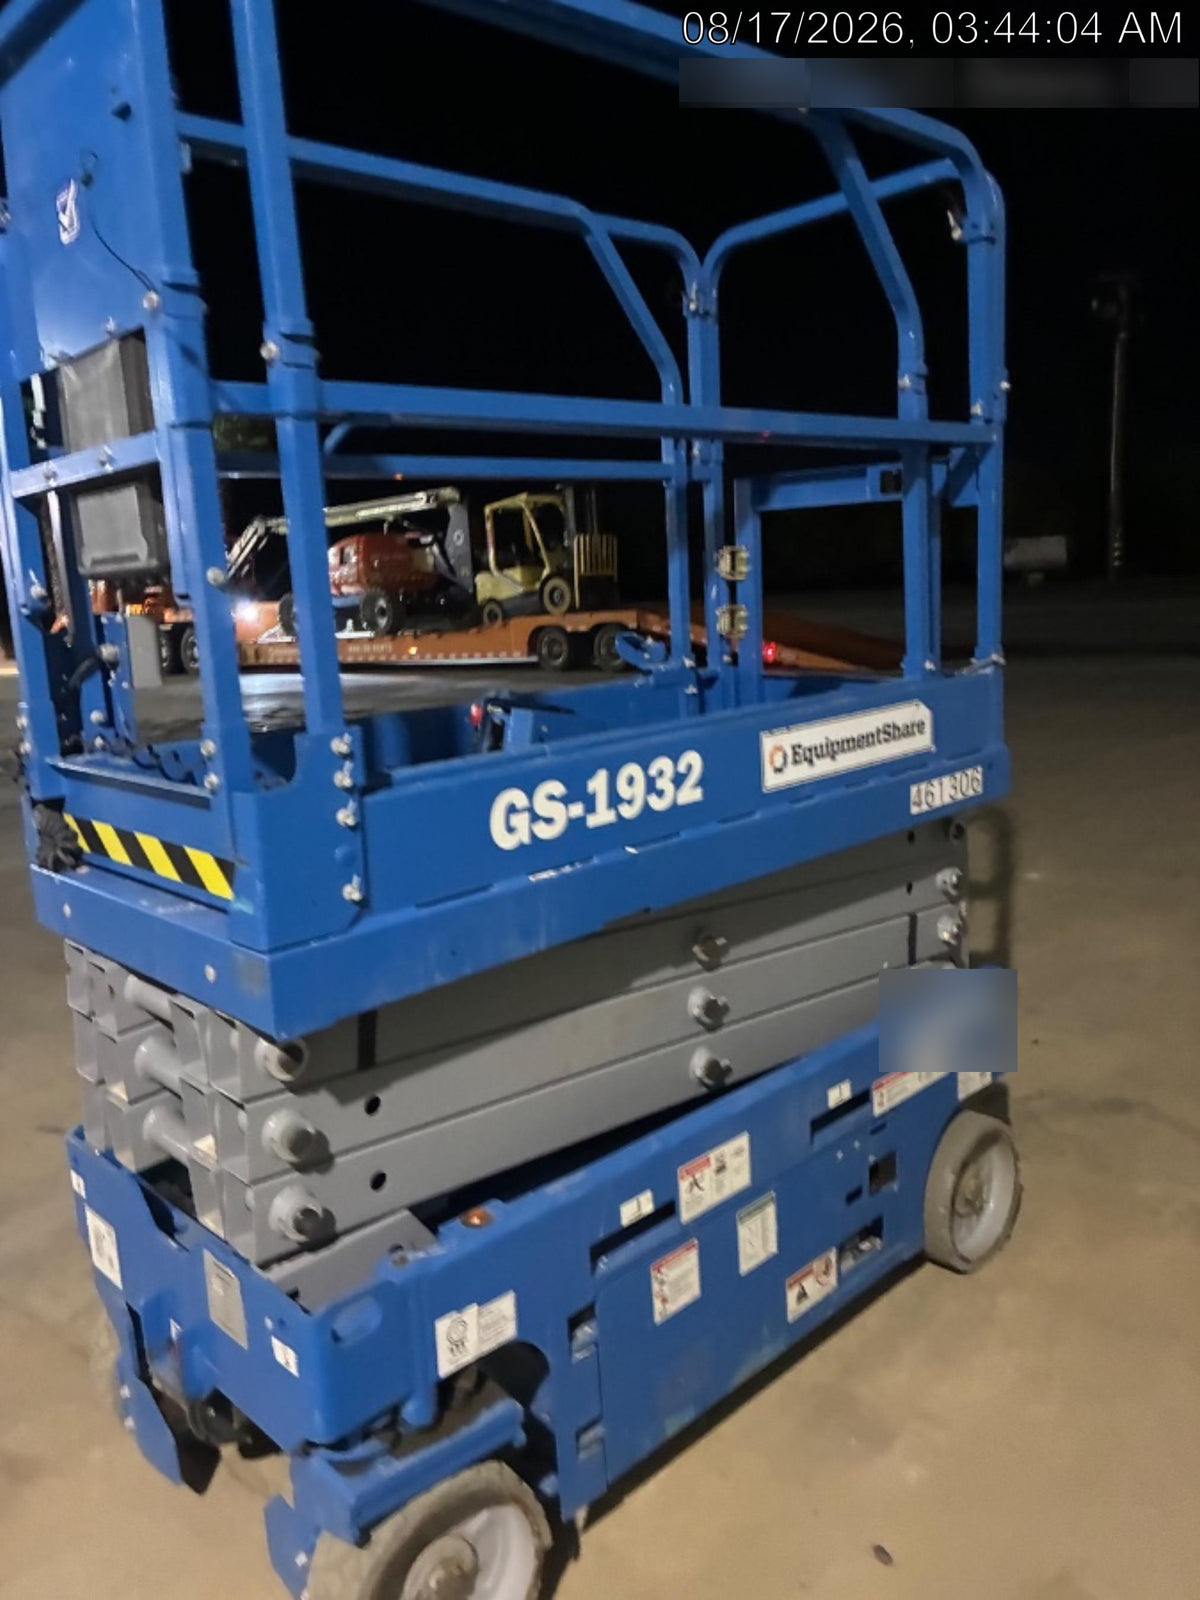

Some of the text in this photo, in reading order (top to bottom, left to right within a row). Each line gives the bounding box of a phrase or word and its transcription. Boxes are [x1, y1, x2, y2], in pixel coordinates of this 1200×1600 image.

[790, 717, 926, 767] EquipmentShare
[489, 749, 705, 851] GS-1932
[910, 766, 983, 809] 461306
